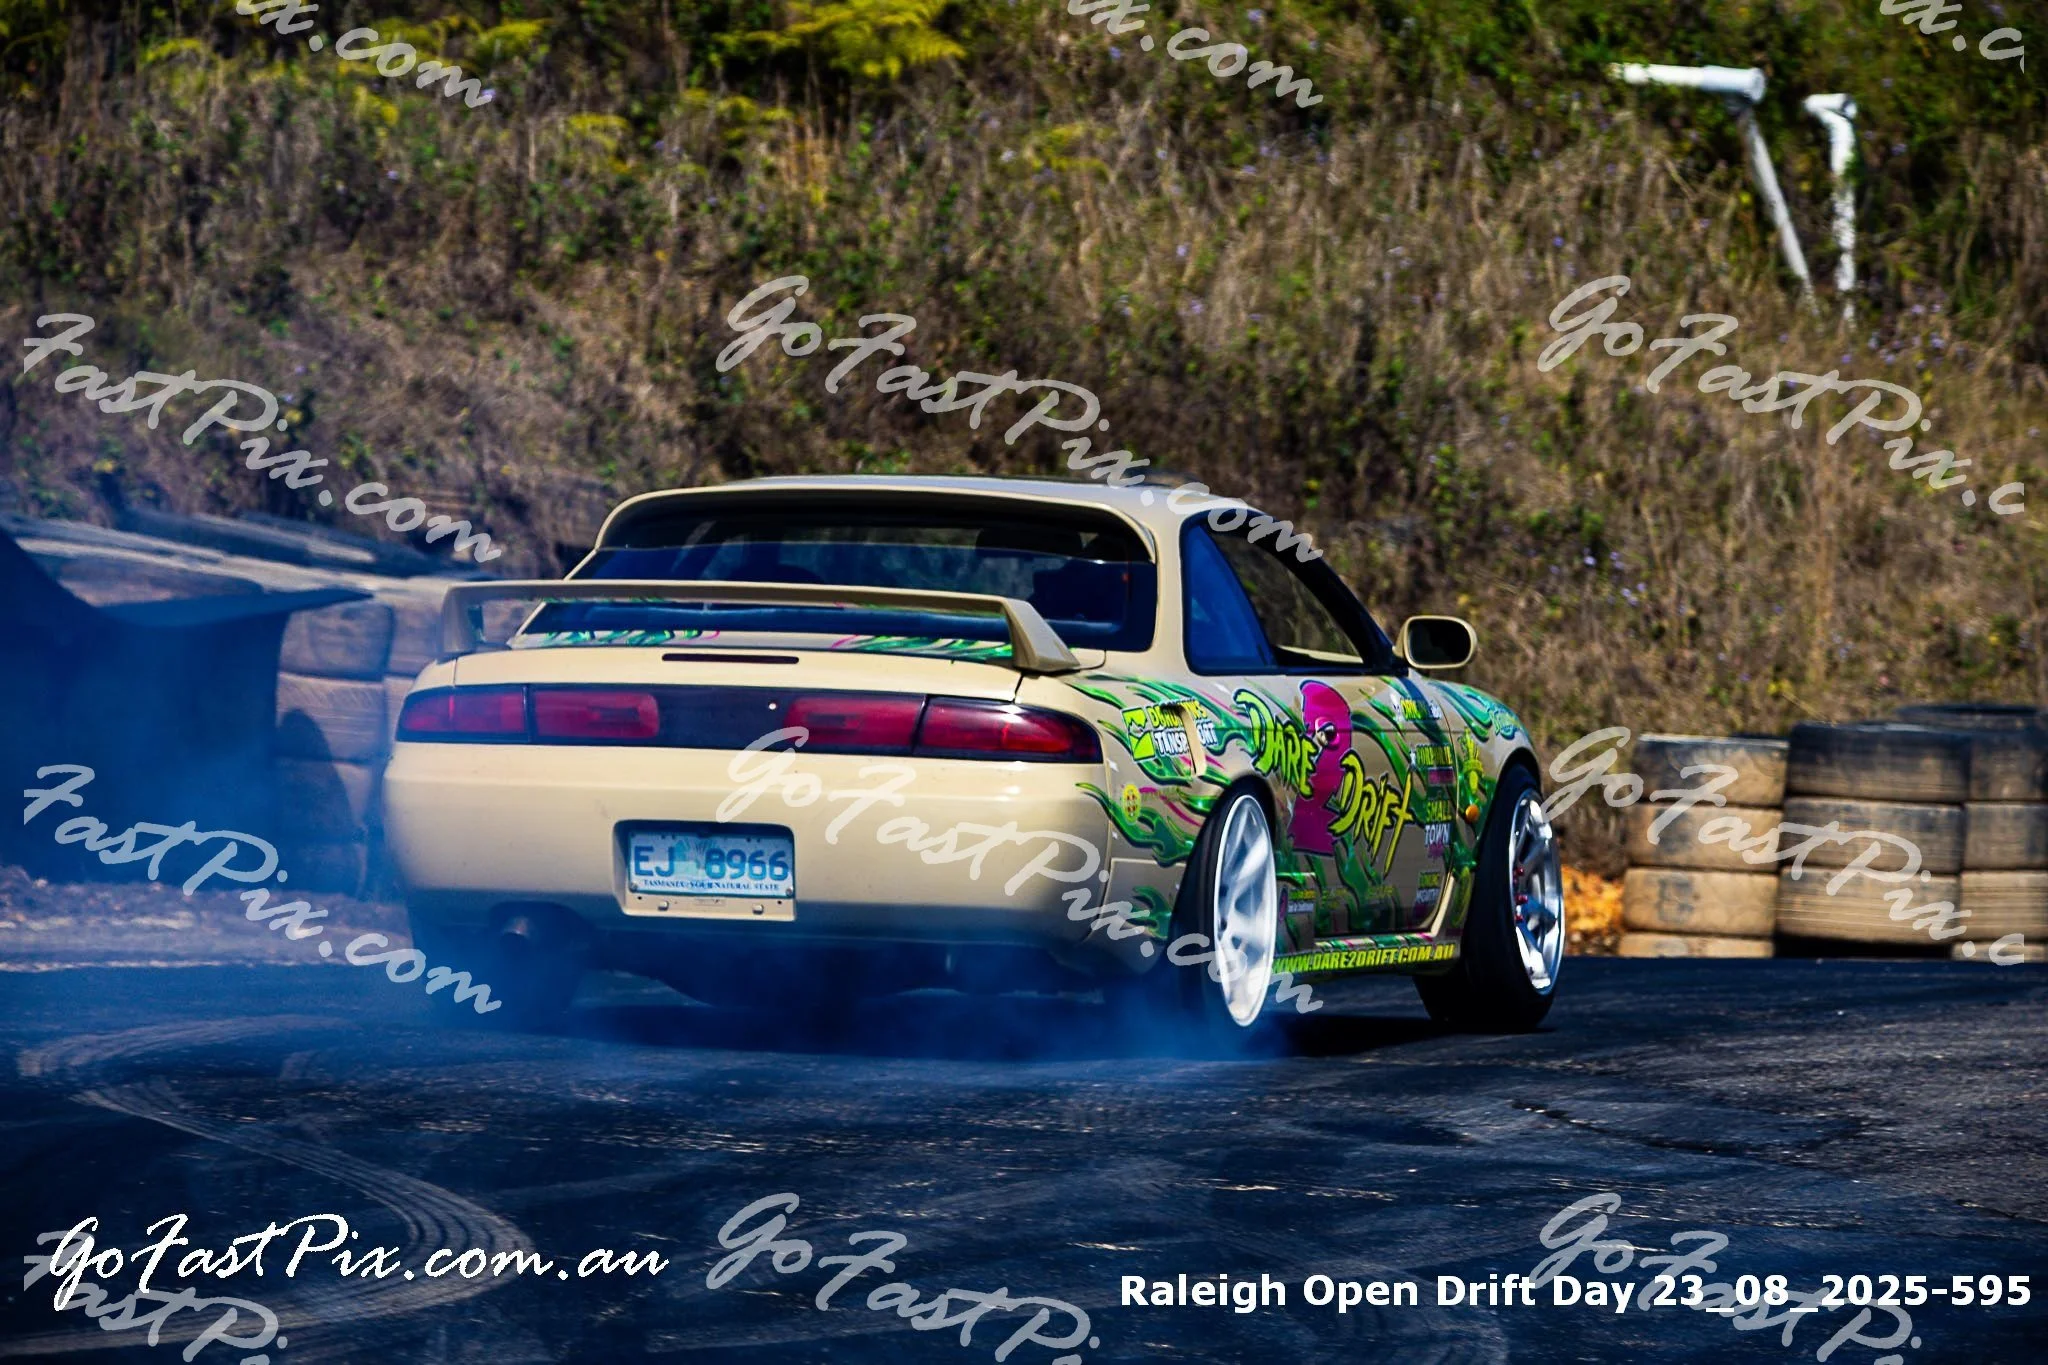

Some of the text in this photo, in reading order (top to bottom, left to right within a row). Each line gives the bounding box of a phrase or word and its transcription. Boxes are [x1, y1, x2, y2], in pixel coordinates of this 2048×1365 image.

[1233, 688, 1320, 799] DARE
[1426, 800, 1453, 821] SMALL
[1424, 823, 1451, 845] TOWN
[634, 846, 789, 881] EJ 8966
